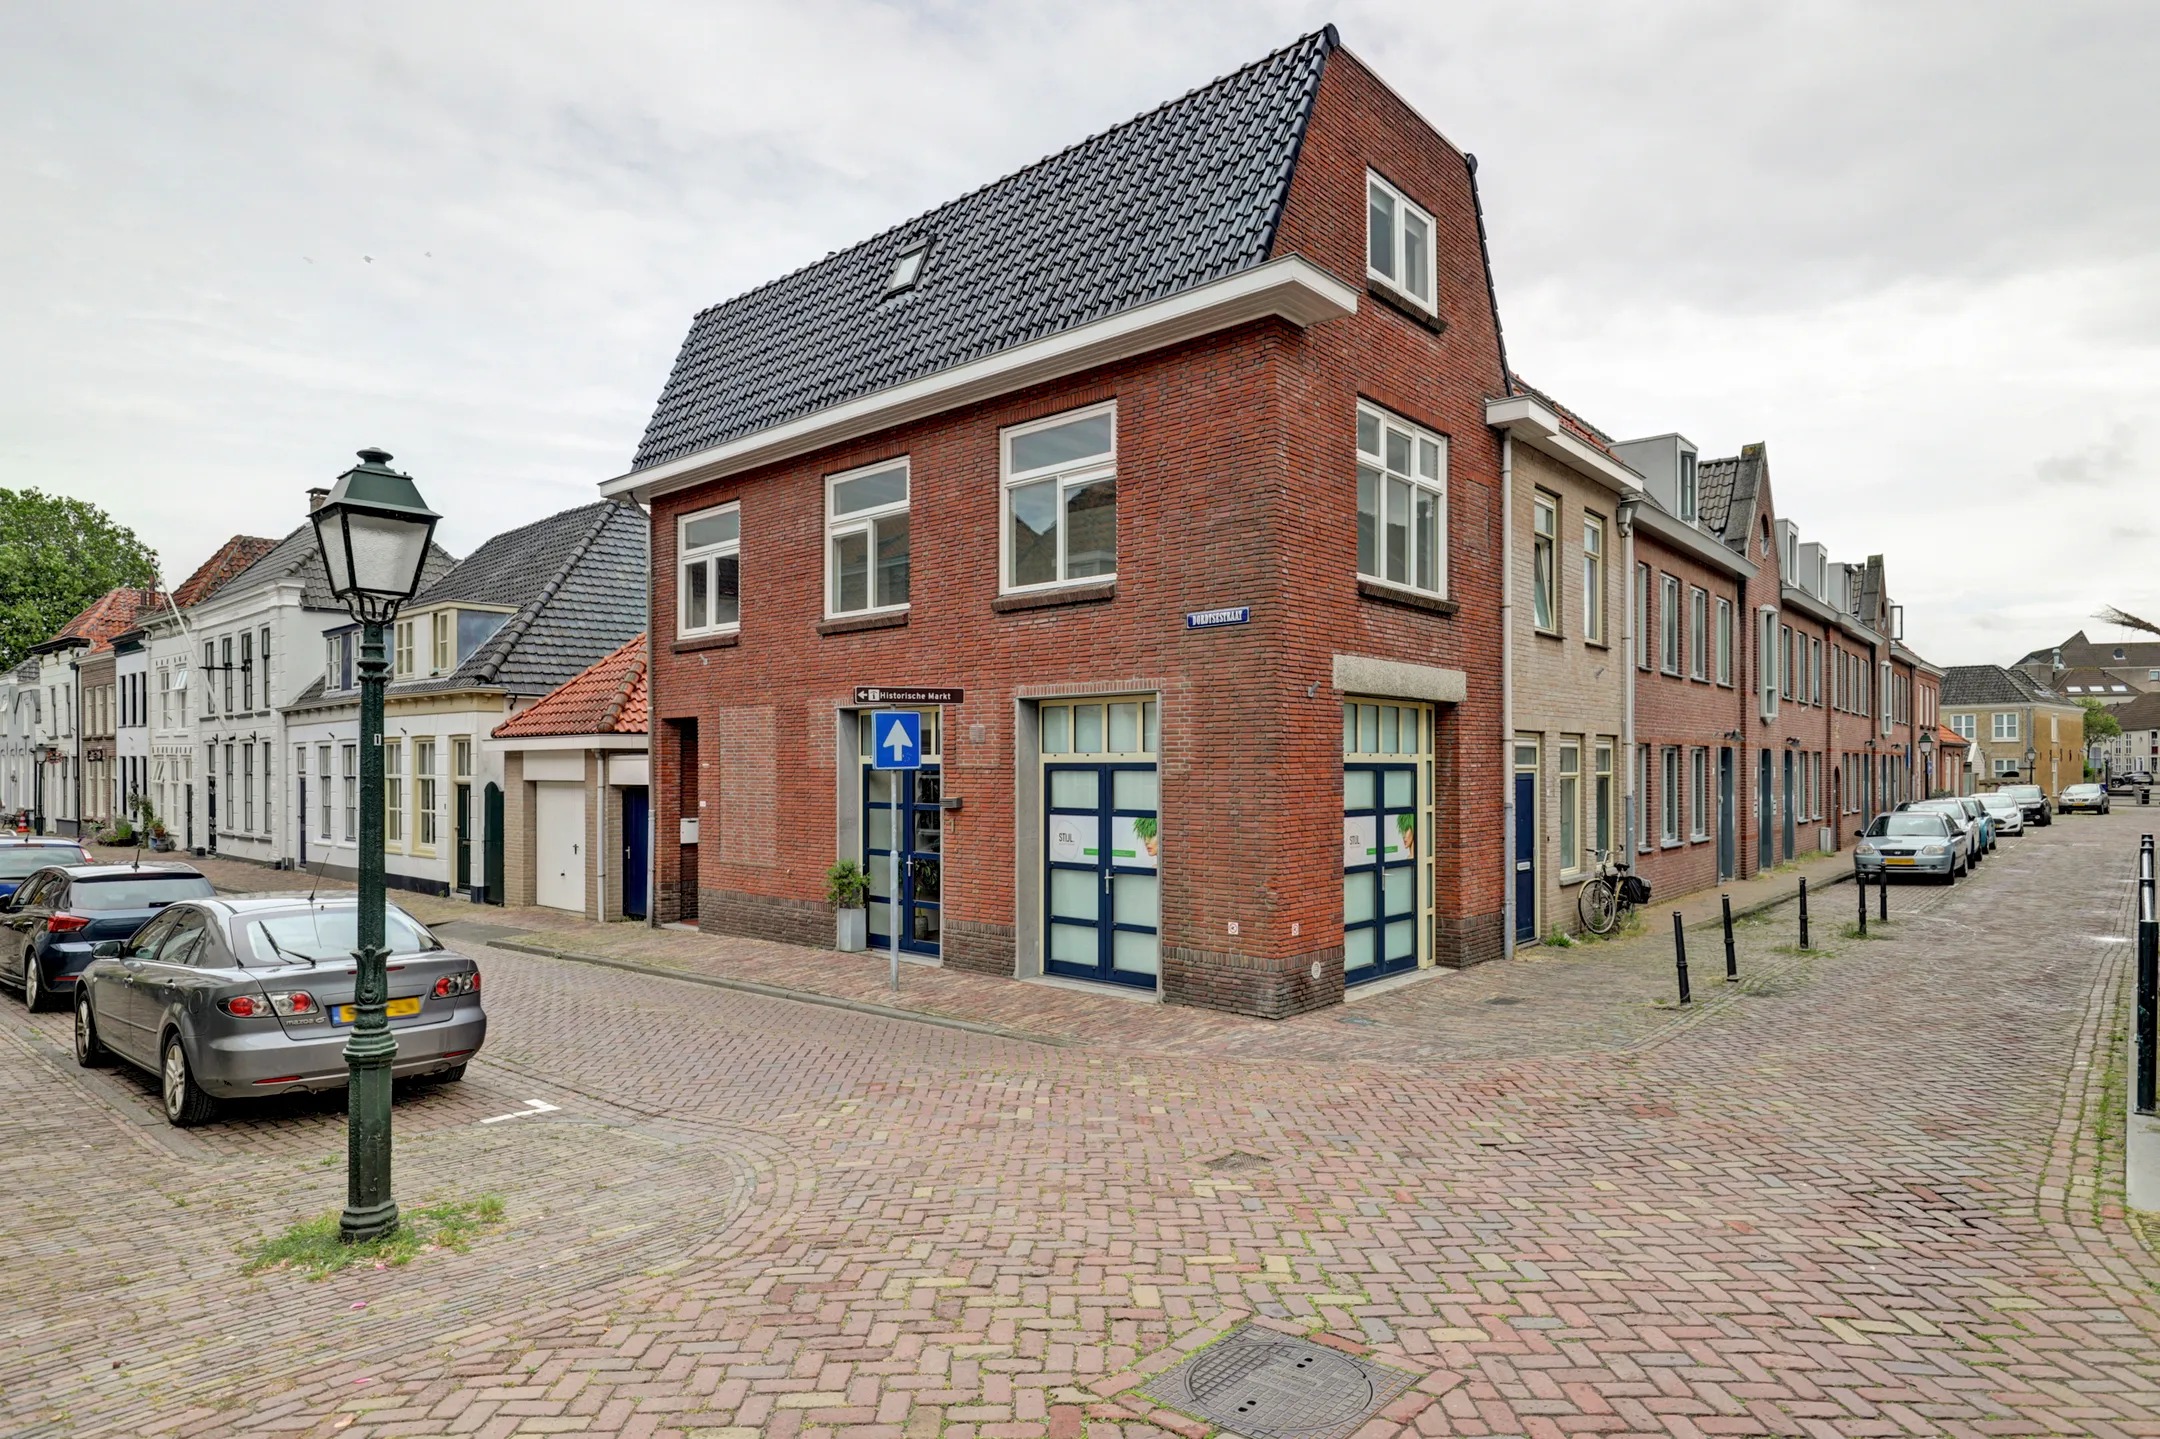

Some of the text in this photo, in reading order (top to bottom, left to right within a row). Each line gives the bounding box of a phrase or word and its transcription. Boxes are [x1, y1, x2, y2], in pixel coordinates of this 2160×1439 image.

[1192, 610, 1243, 626] DORDTSESTRAAT
[880, 691, 952, 700] Historische Markt
